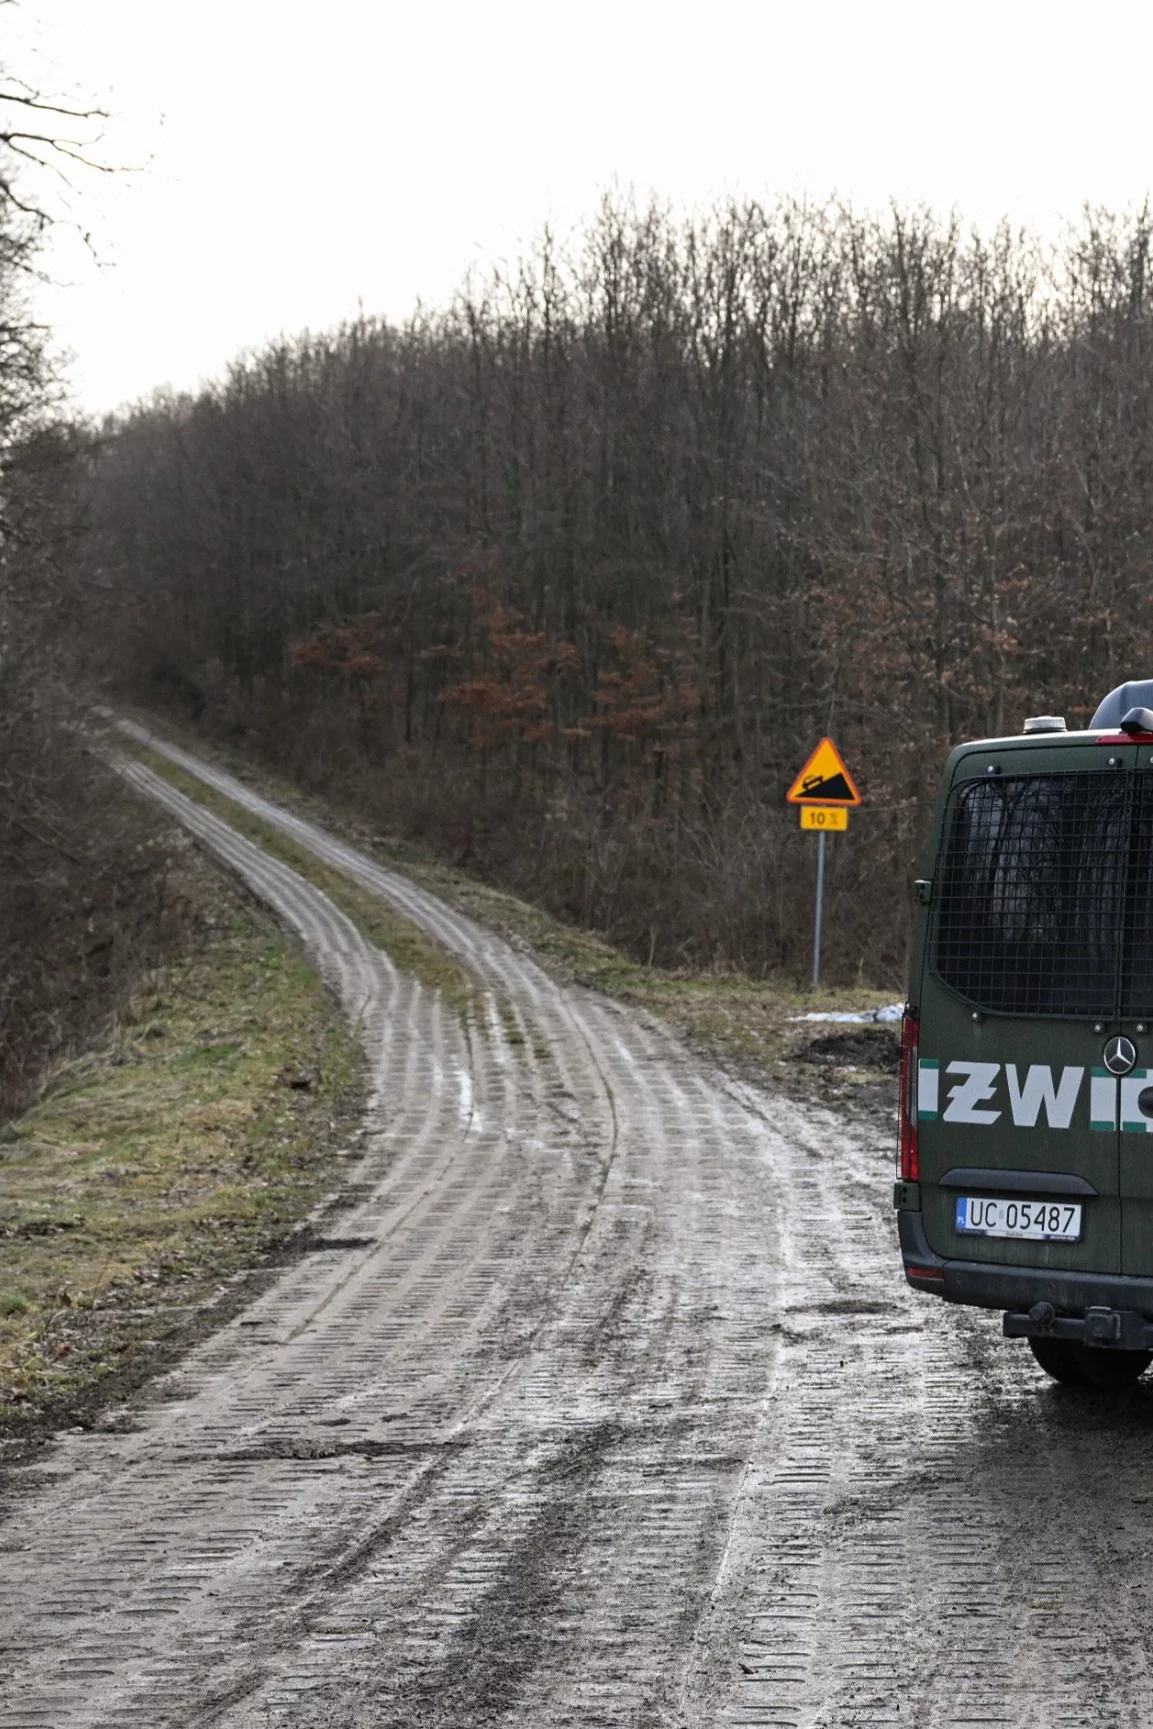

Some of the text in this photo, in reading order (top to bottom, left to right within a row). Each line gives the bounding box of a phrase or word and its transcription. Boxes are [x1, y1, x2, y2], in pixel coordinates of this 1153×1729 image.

[810, 812, 826, 825] 10
[970, 1200, 1076, 1233] UC 05487
